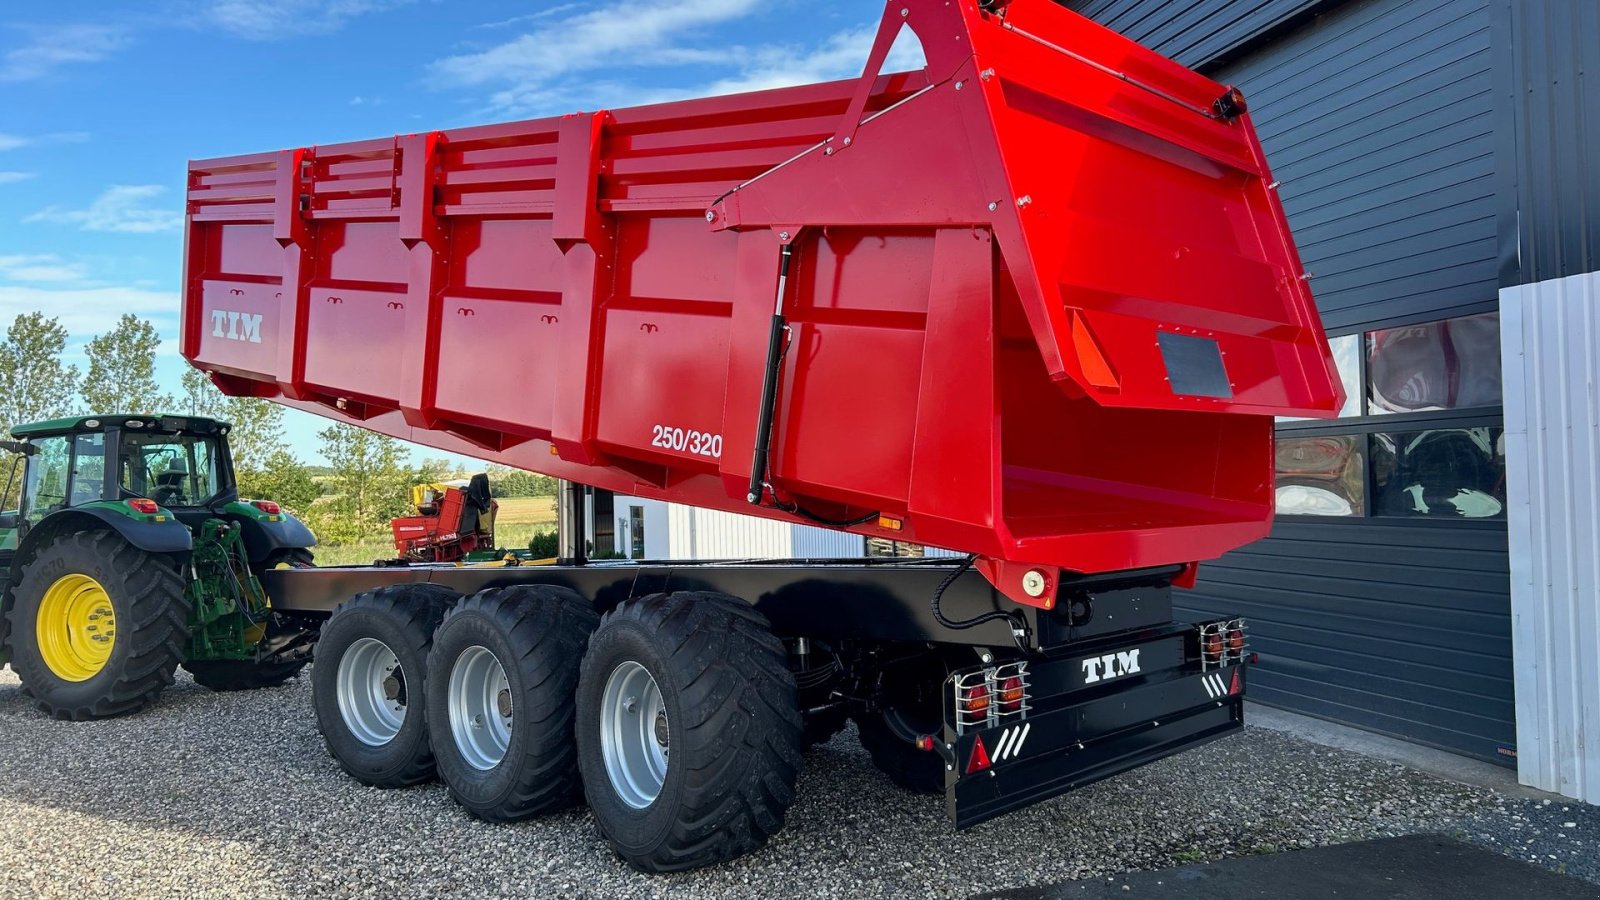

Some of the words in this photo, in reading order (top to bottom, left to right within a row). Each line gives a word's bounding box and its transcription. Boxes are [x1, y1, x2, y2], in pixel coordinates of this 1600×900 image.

[211, 309, 263, 344] TIM
[652, 424, 722, 458] 250/320
[1082, 648, 1140, 684] TIM
